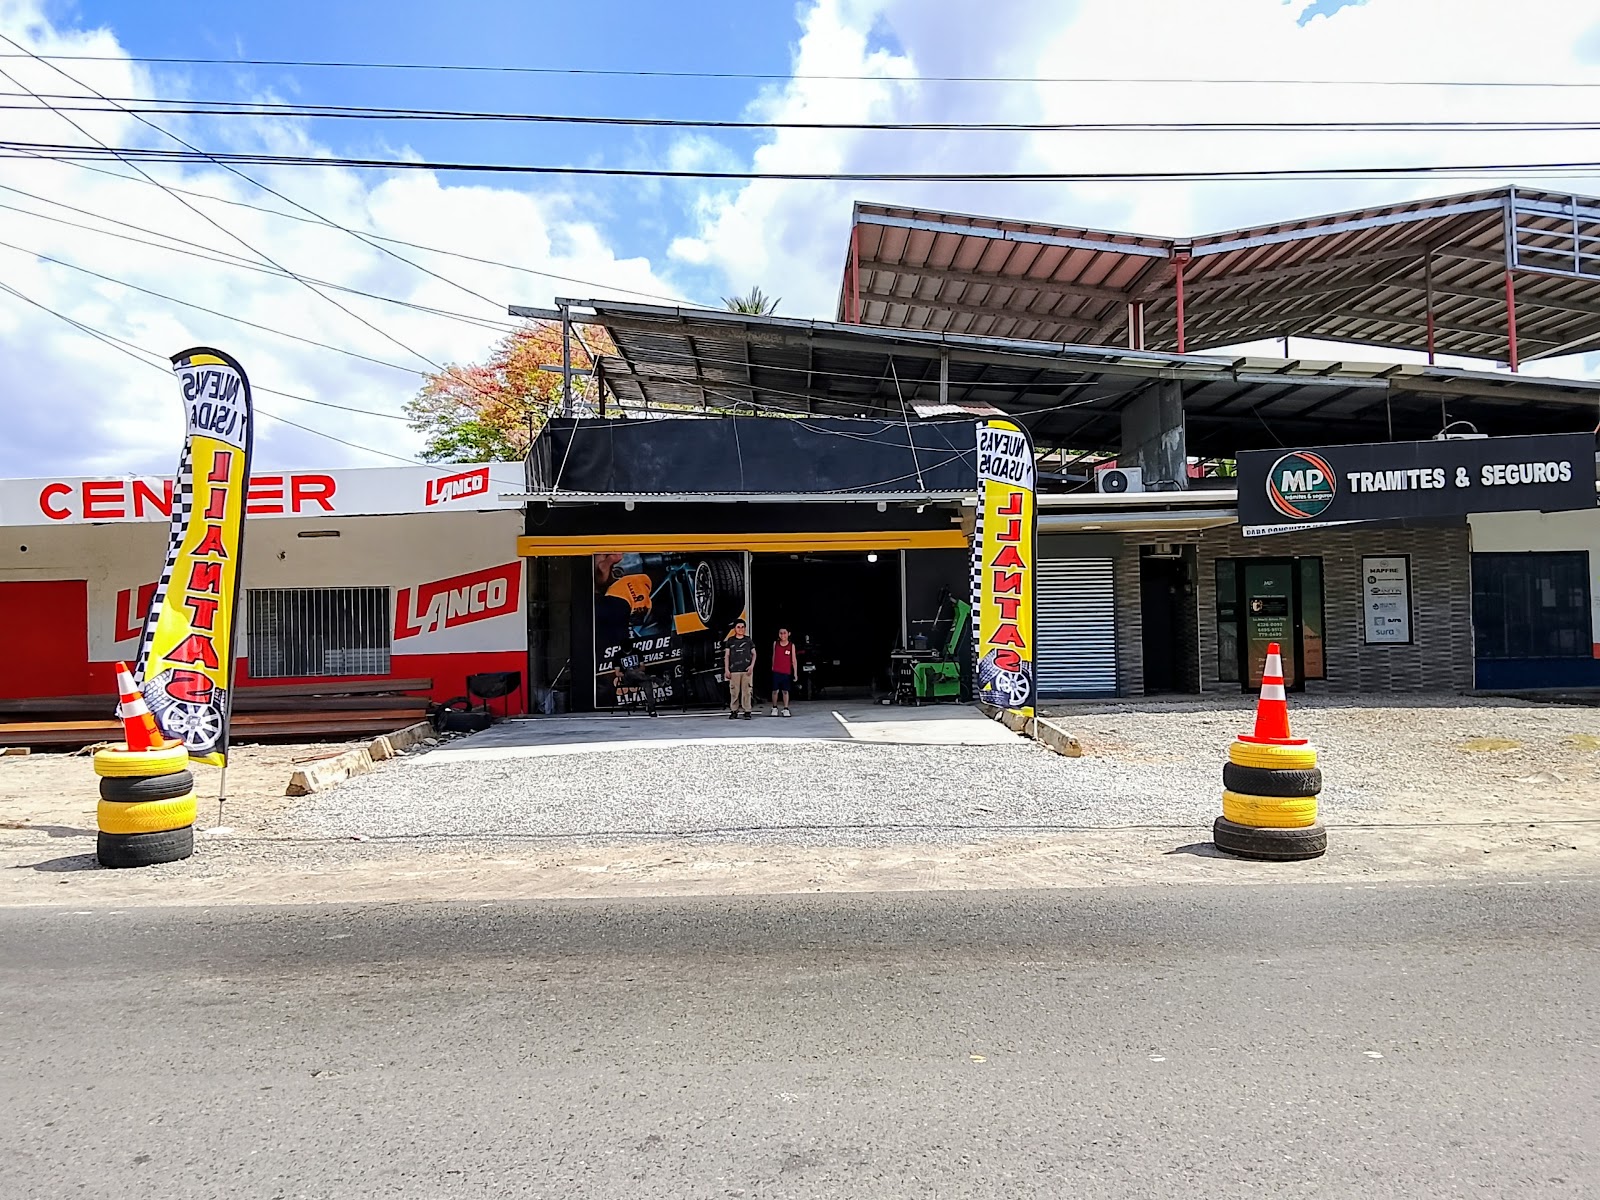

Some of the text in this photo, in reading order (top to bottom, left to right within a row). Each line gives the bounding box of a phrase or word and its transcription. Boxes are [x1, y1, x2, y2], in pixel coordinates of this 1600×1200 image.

[426, 470, 486, 505] LANCO
[1281, 469, 1324, 492] MP
[1346, 461, 1572, 493] TRAMITES & SEGUROS
[39, 474, 337, 520] CENER
[395, 570, 512, 638] LANCO
[656, 637, 671, 649] DE
